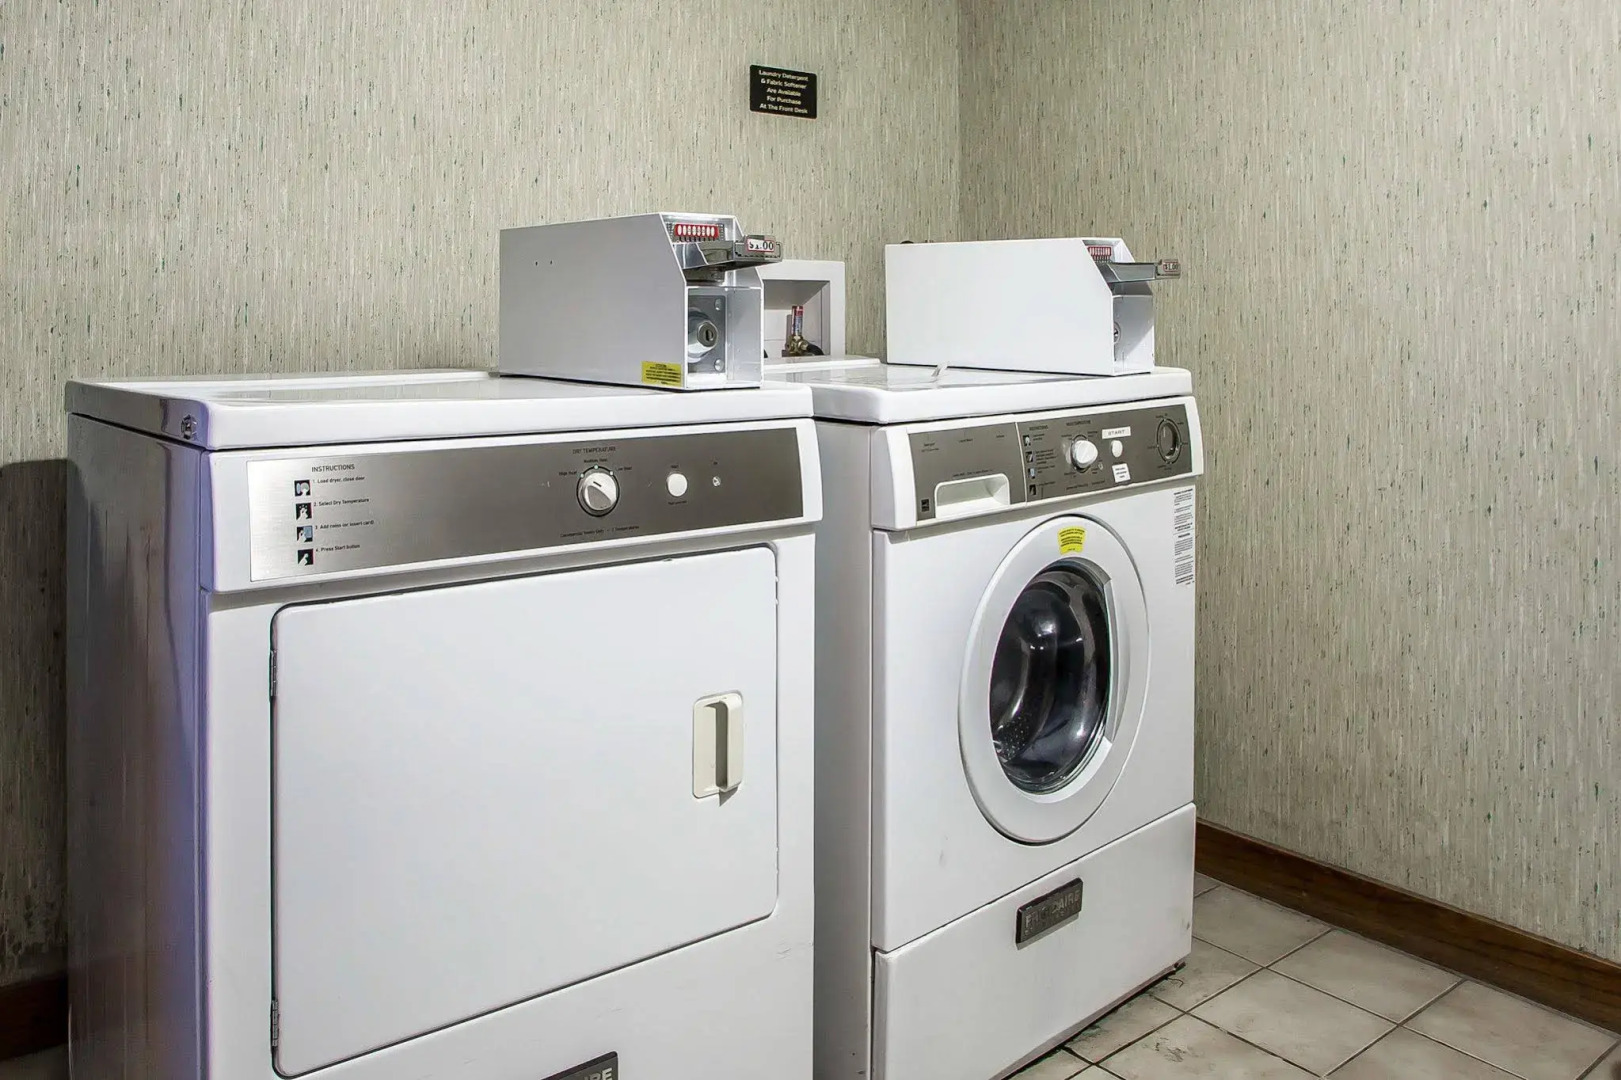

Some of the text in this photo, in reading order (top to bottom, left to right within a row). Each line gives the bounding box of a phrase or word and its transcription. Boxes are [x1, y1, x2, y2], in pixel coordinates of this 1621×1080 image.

[758, 70, 808, 81] Laundry Detergent
[767, 79, 783, 87] Fabric
[784, 81, 807, 89] Softener
[778, 89, 801, 97] Available
[777, 97, 801, 105] Purchase
[748, 240, 774, 251] $1.00
[311, 464, 355, 472] INSTRUCTIONS
